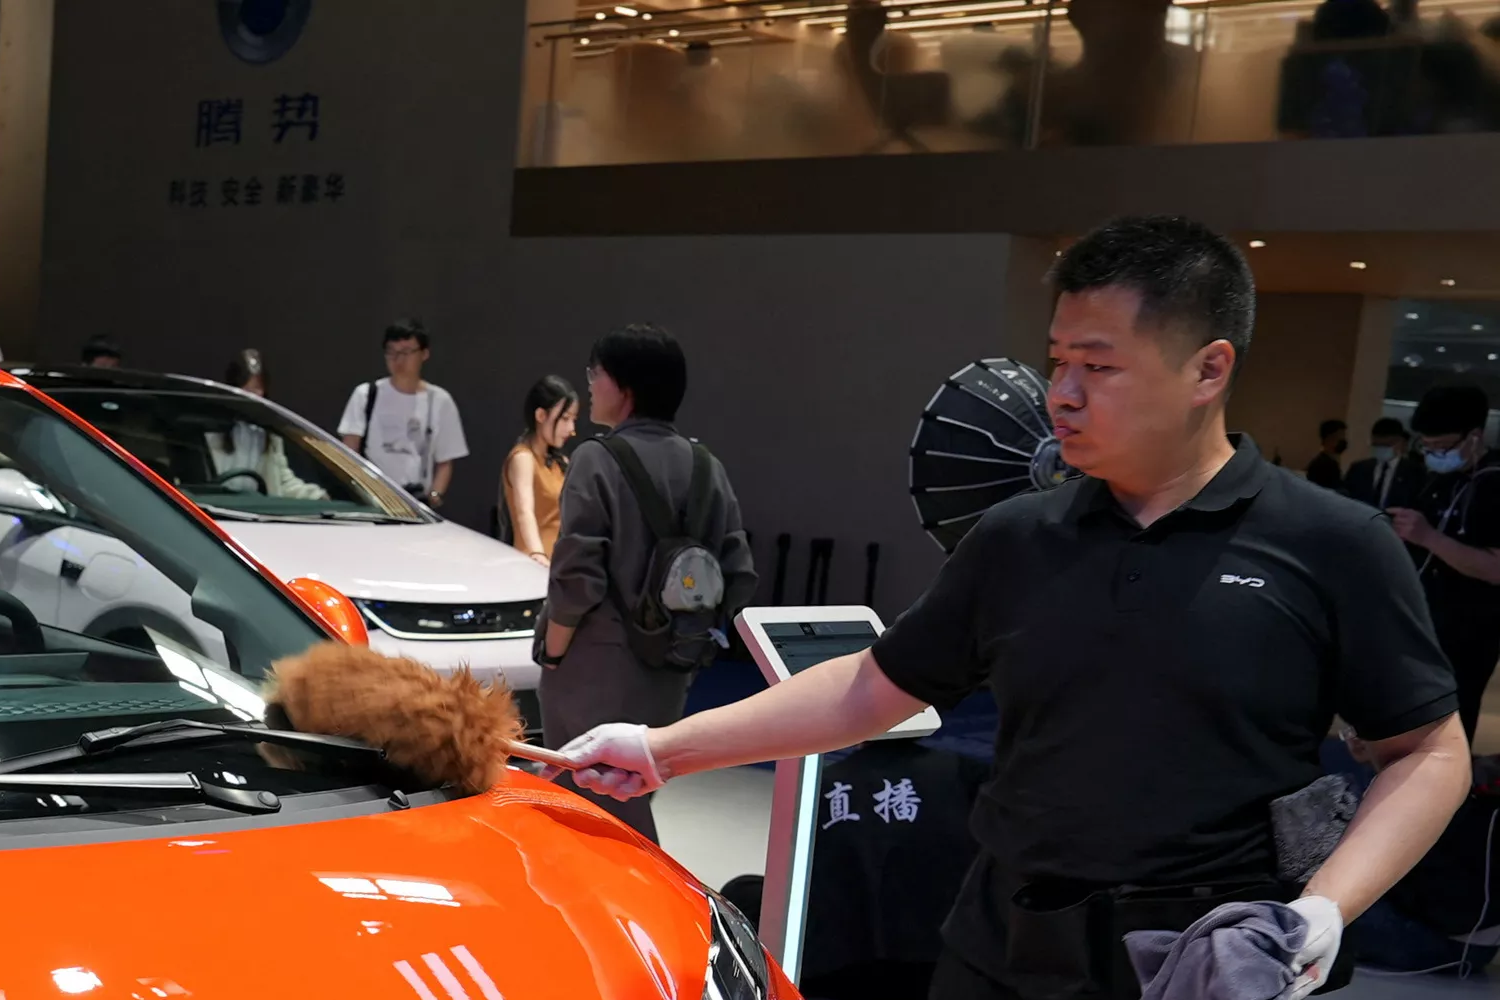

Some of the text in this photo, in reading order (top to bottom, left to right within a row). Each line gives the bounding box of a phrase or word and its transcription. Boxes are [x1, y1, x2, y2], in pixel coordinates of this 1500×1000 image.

[195, 93, 320, 148] 腾势
[220, 176, 264, 207] 安全
[1219, 574, 1266, 588] BYD
[822, 777, 923, 830] 直播
